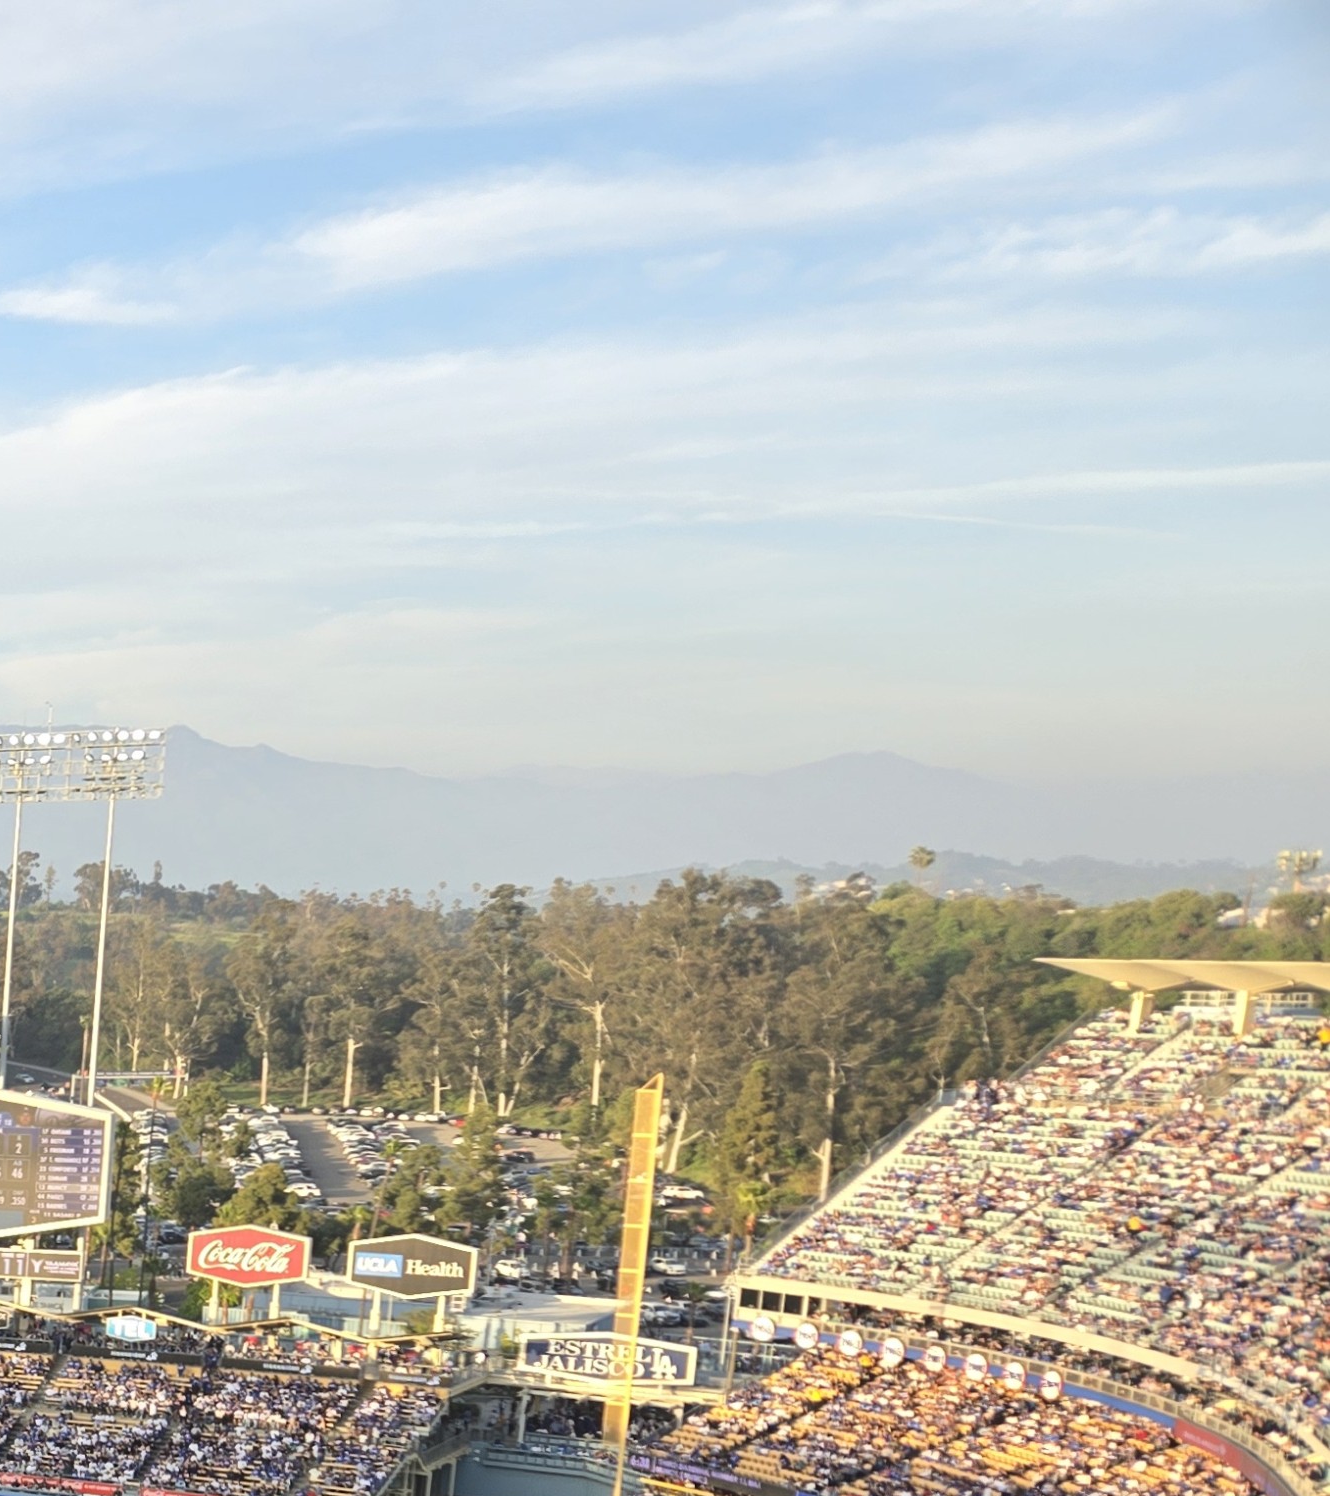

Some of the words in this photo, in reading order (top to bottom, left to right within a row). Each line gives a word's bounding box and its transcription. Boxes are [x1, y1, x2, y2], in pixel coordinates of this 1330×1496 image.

[15, 1143, 22, 1154] 2
[11, 1168, 23, 1179] 46
[197, 1239, 296, 1274] Coca-Cola
[357, 1257, 399, 1275] UCLA
[405, 1258, 465, 1279] Health
[534, 1354, 645, 1378] JALISCO
